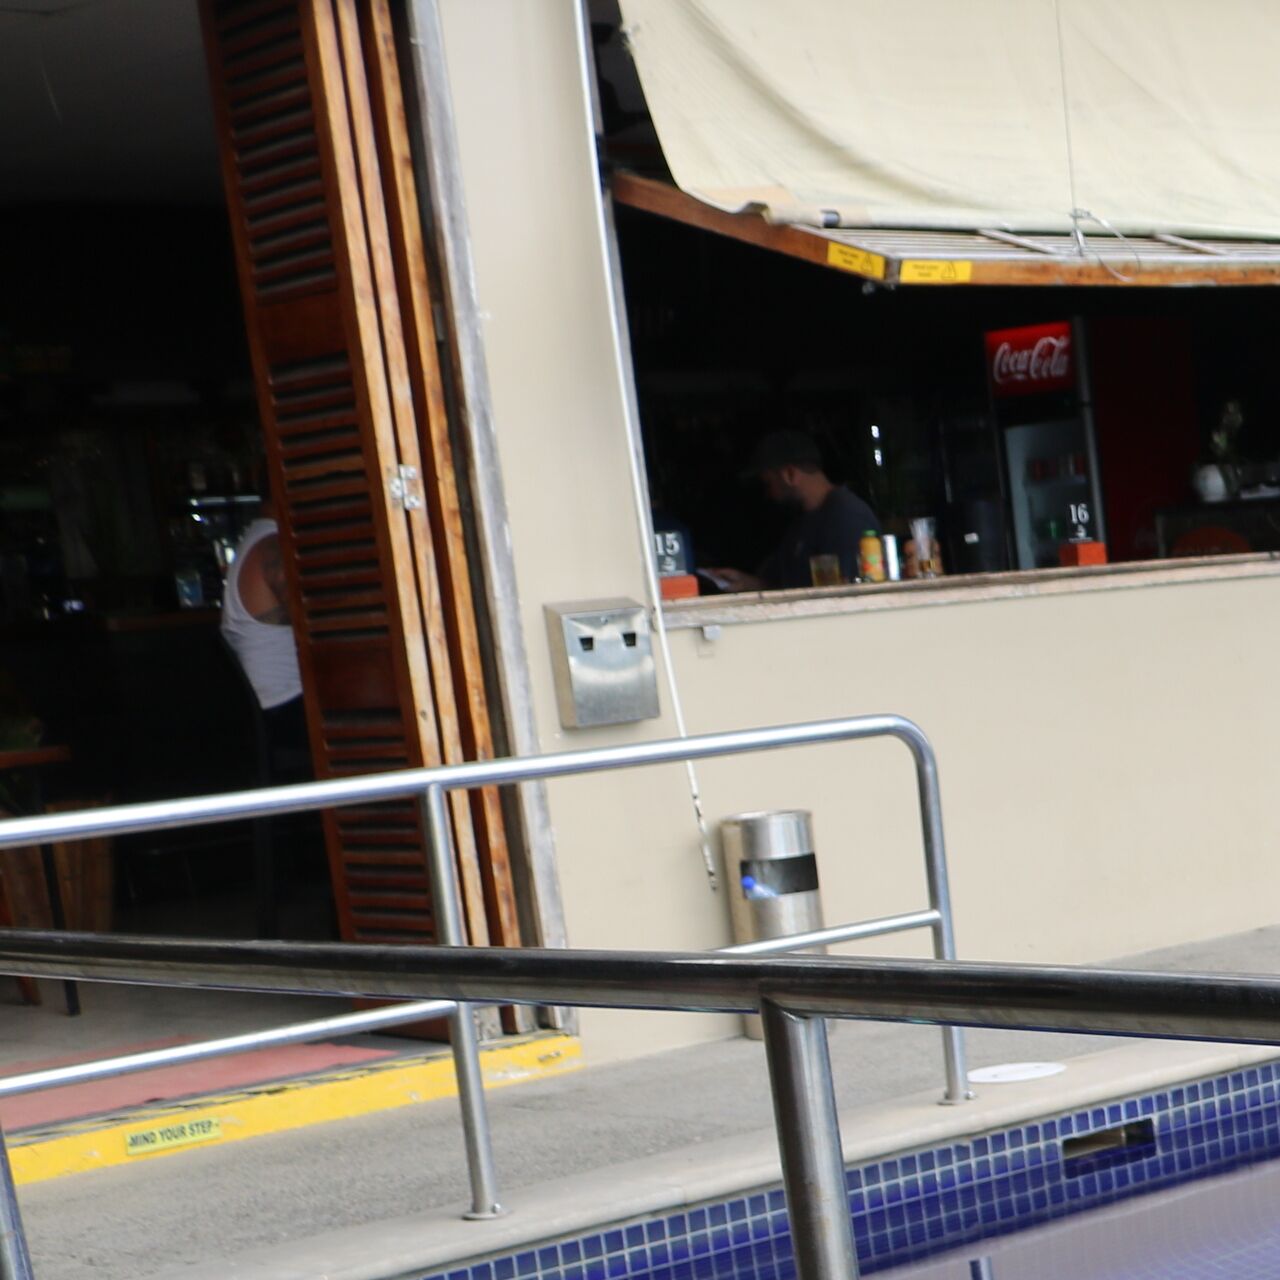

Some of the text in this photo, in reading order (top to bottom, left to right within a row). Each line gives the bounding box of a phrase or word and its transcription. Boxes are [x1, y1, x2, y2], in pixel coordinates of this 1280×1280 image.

[1070, 503, 1089, 524] 16
[656, 533, 680, 556] 15
[128, 1119, 212, 1147] MIND YOUR STEP
